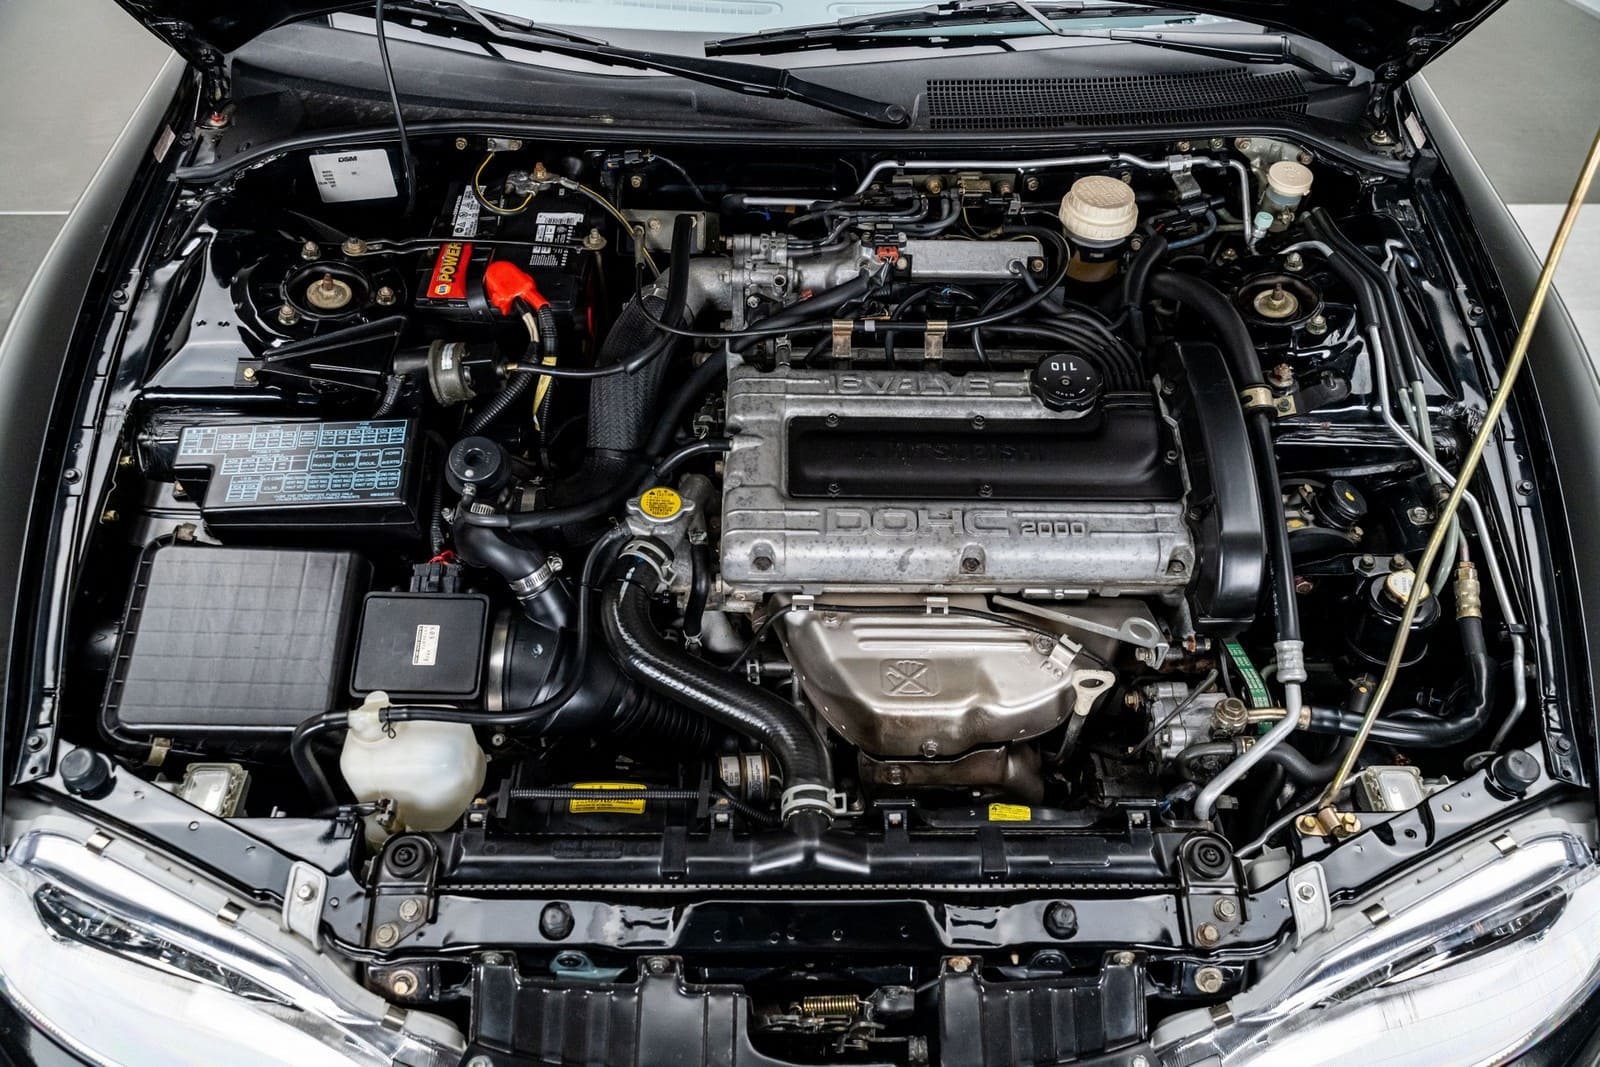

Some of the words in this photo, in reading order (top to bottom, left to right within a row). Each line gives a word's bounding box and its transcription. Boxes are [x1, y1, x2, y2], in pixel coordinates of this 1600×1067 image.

[338, 155, 358, 163] DSM
[438, 242, 463, 283] POWER
[1050, 361, 1078, 372] OIL
[825, 509, 1009, 536] DOHC
[1020, 521, 1089, 537] 2000
